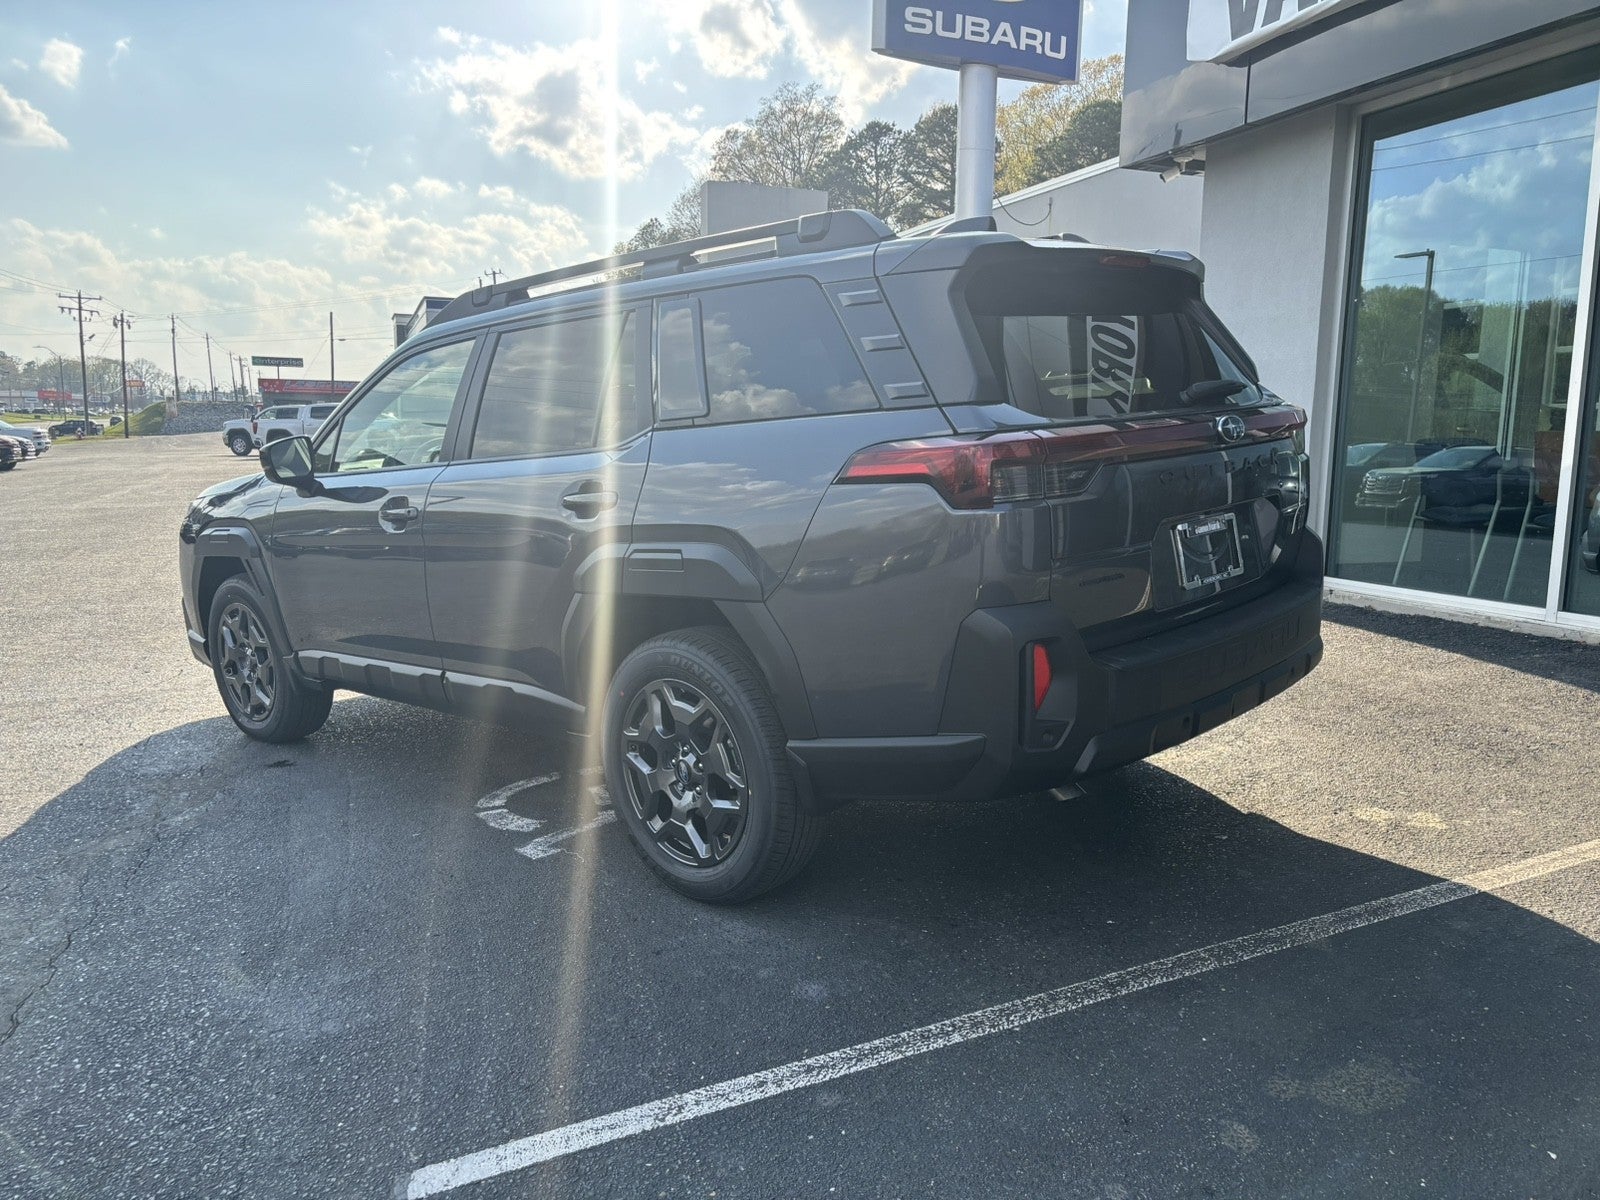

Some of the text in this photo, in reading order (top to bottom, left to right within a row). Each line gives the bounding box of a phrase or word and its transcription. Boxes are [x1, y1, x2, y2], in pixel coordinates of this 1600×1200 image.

[904, 6, 1067, 60] SUBARU
[254, 358, 303, 366] enterprise
[1159, 447, 1279, 483] OUTBACK
